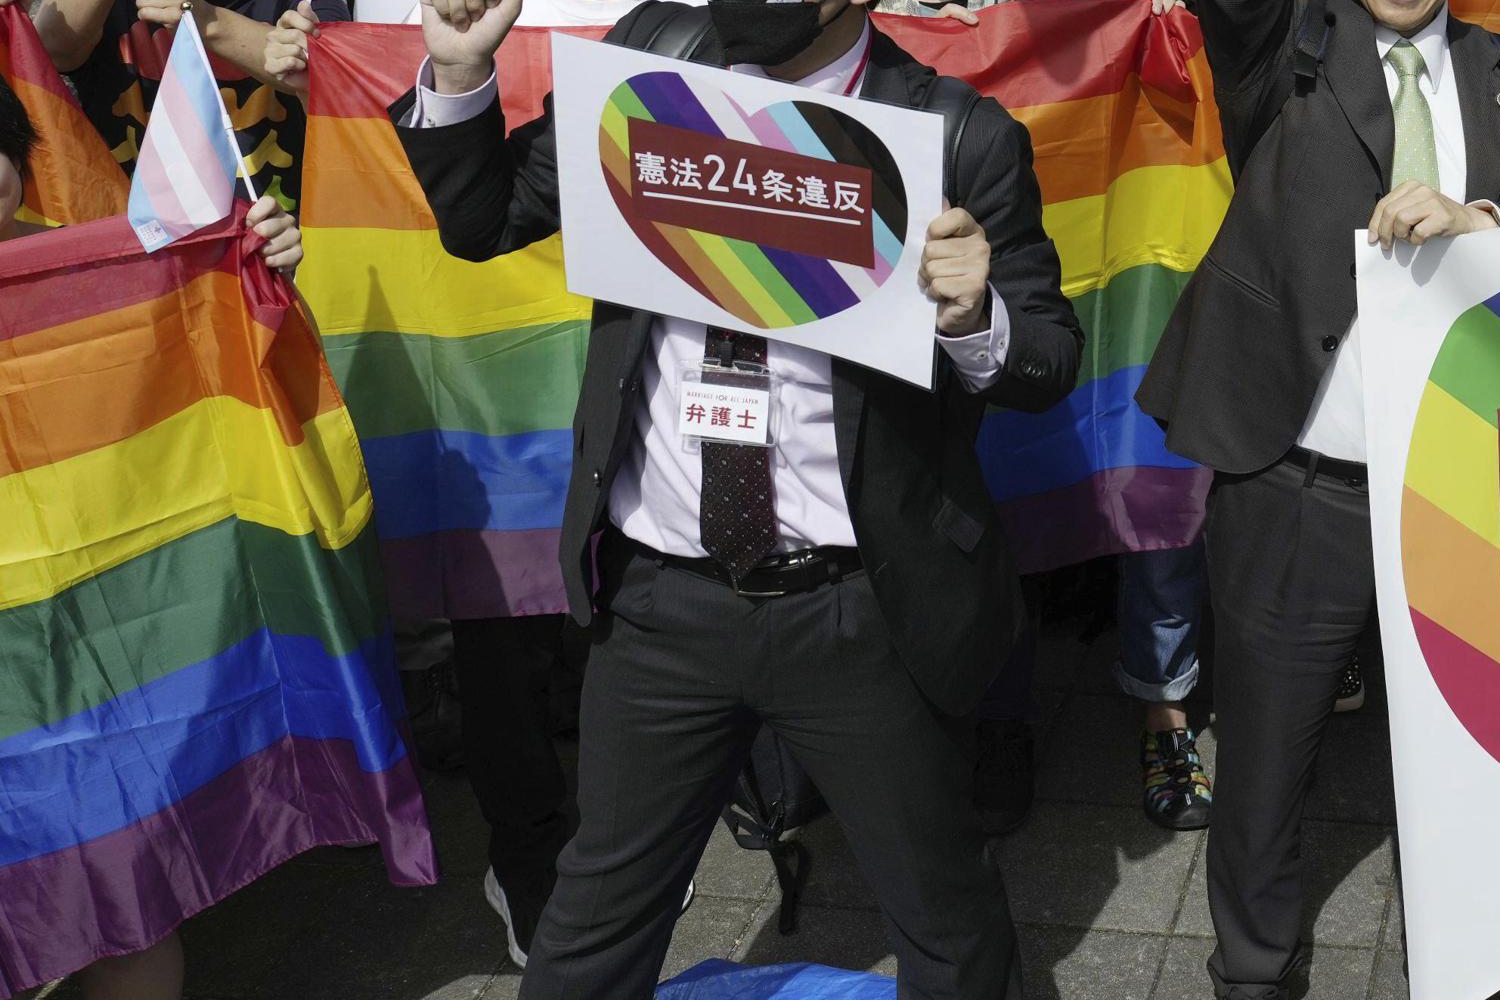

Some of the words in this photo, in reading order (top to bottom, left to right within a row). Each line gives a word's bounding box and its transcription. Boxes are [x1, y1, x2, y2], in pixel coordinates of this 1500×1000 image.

[634, 151, 865, 214] 憲法24条違反
[686, 403, 757, 429] 弁護士
